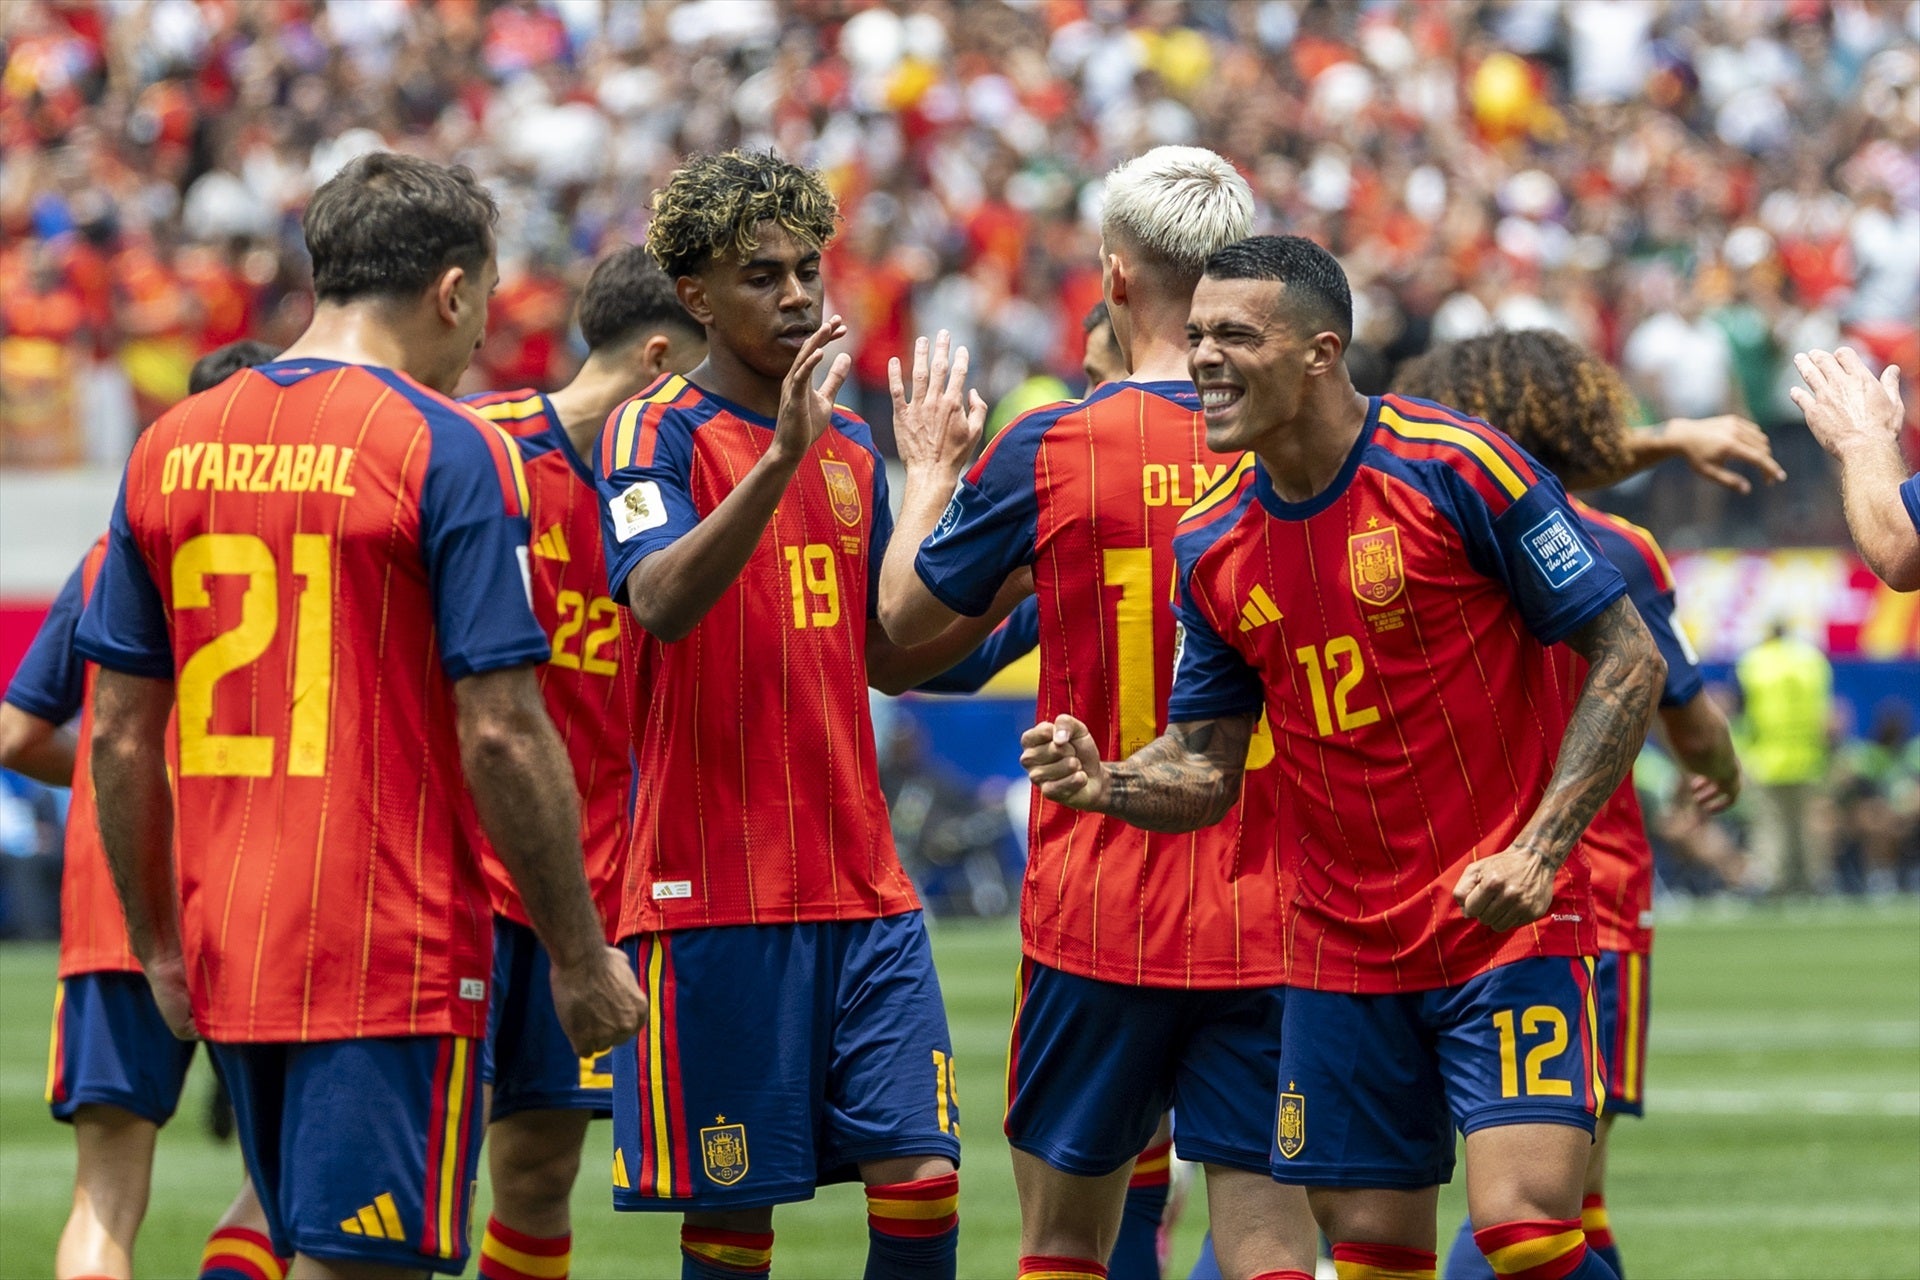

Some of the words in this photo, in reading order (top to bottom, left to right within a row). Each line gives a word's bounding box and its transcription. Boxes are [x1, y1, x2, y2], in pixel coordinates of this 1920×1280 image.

[161, 442, 356, 496] OYARZABAL
[1532, 521, 1564, 548] FOOTBALL
[1538, 529, 1571, 559] UNITES
[784, 544, 841, 628] 19
[172, 533, 332, 777] 21
[550, 590, 621, 676] 22
[1297, 635, 1381, 736] 12
[1493, 1005, 1572, 1098] 12
